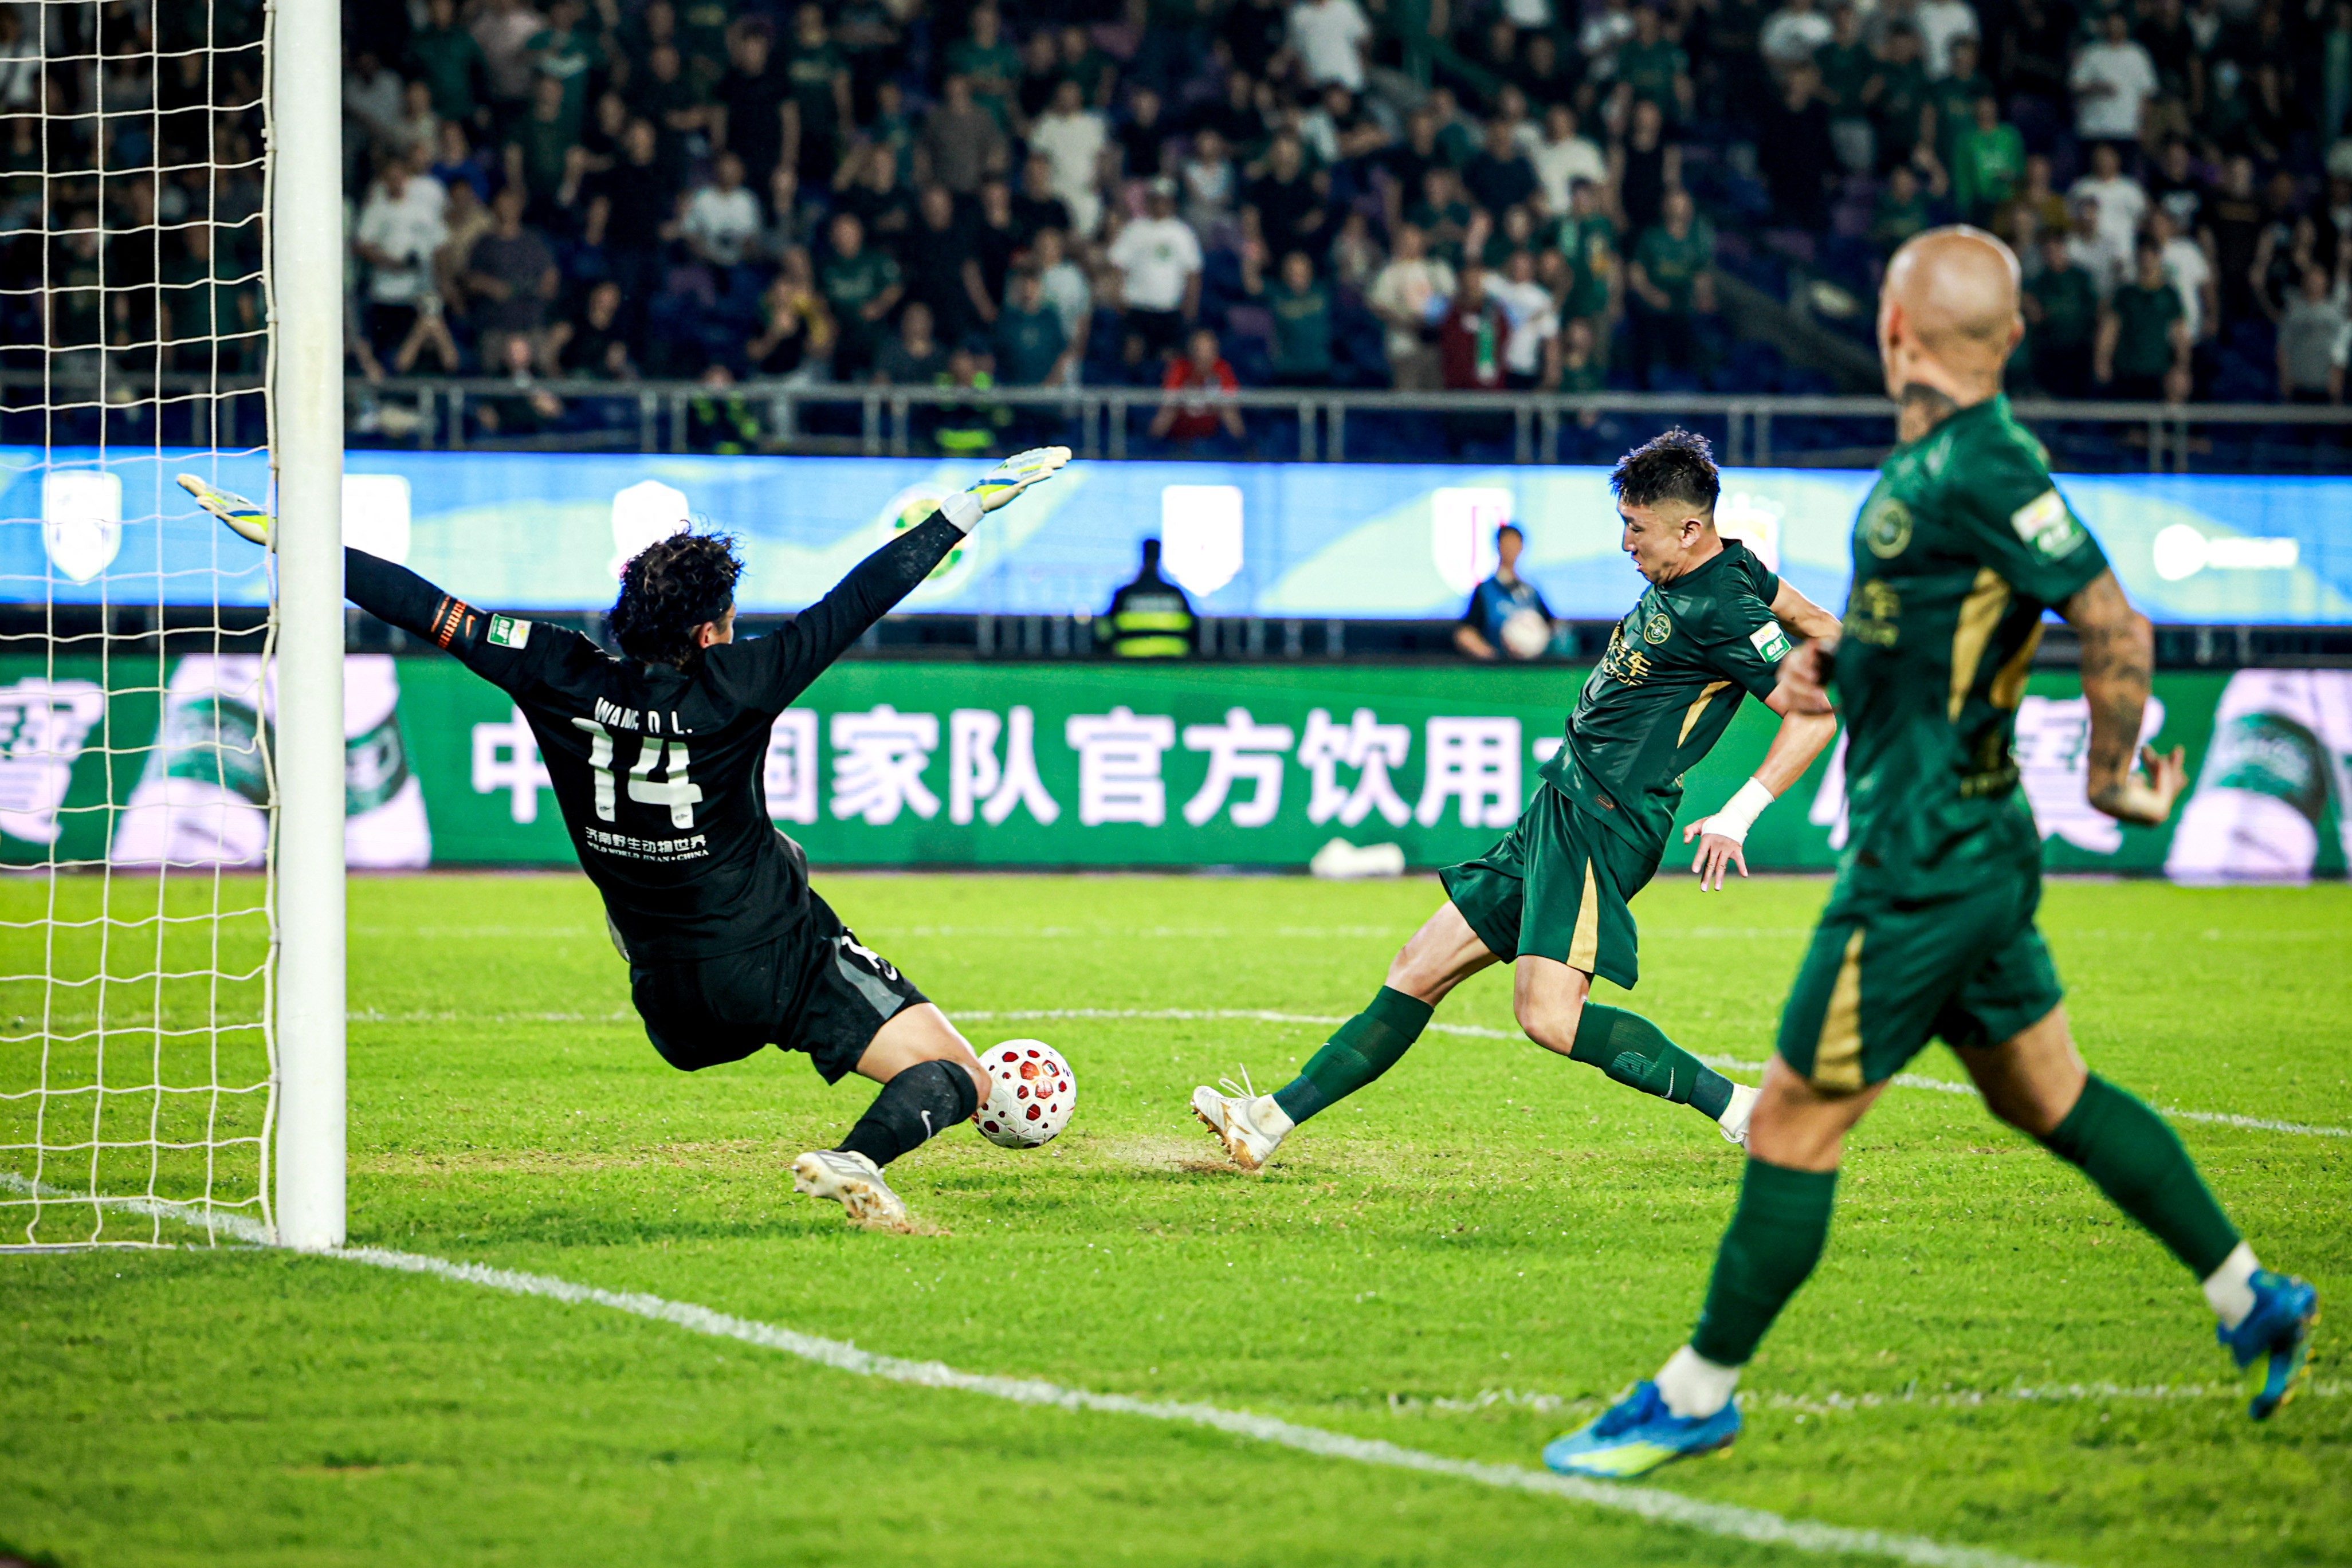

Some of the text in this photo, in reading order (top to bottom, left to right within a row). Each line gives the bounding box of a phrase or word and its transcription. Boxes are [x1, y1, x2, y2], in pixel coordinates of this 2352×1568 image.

[571, 717, 704, 830] 14
[585, 826, 706, 854] 济南野生动物世界
